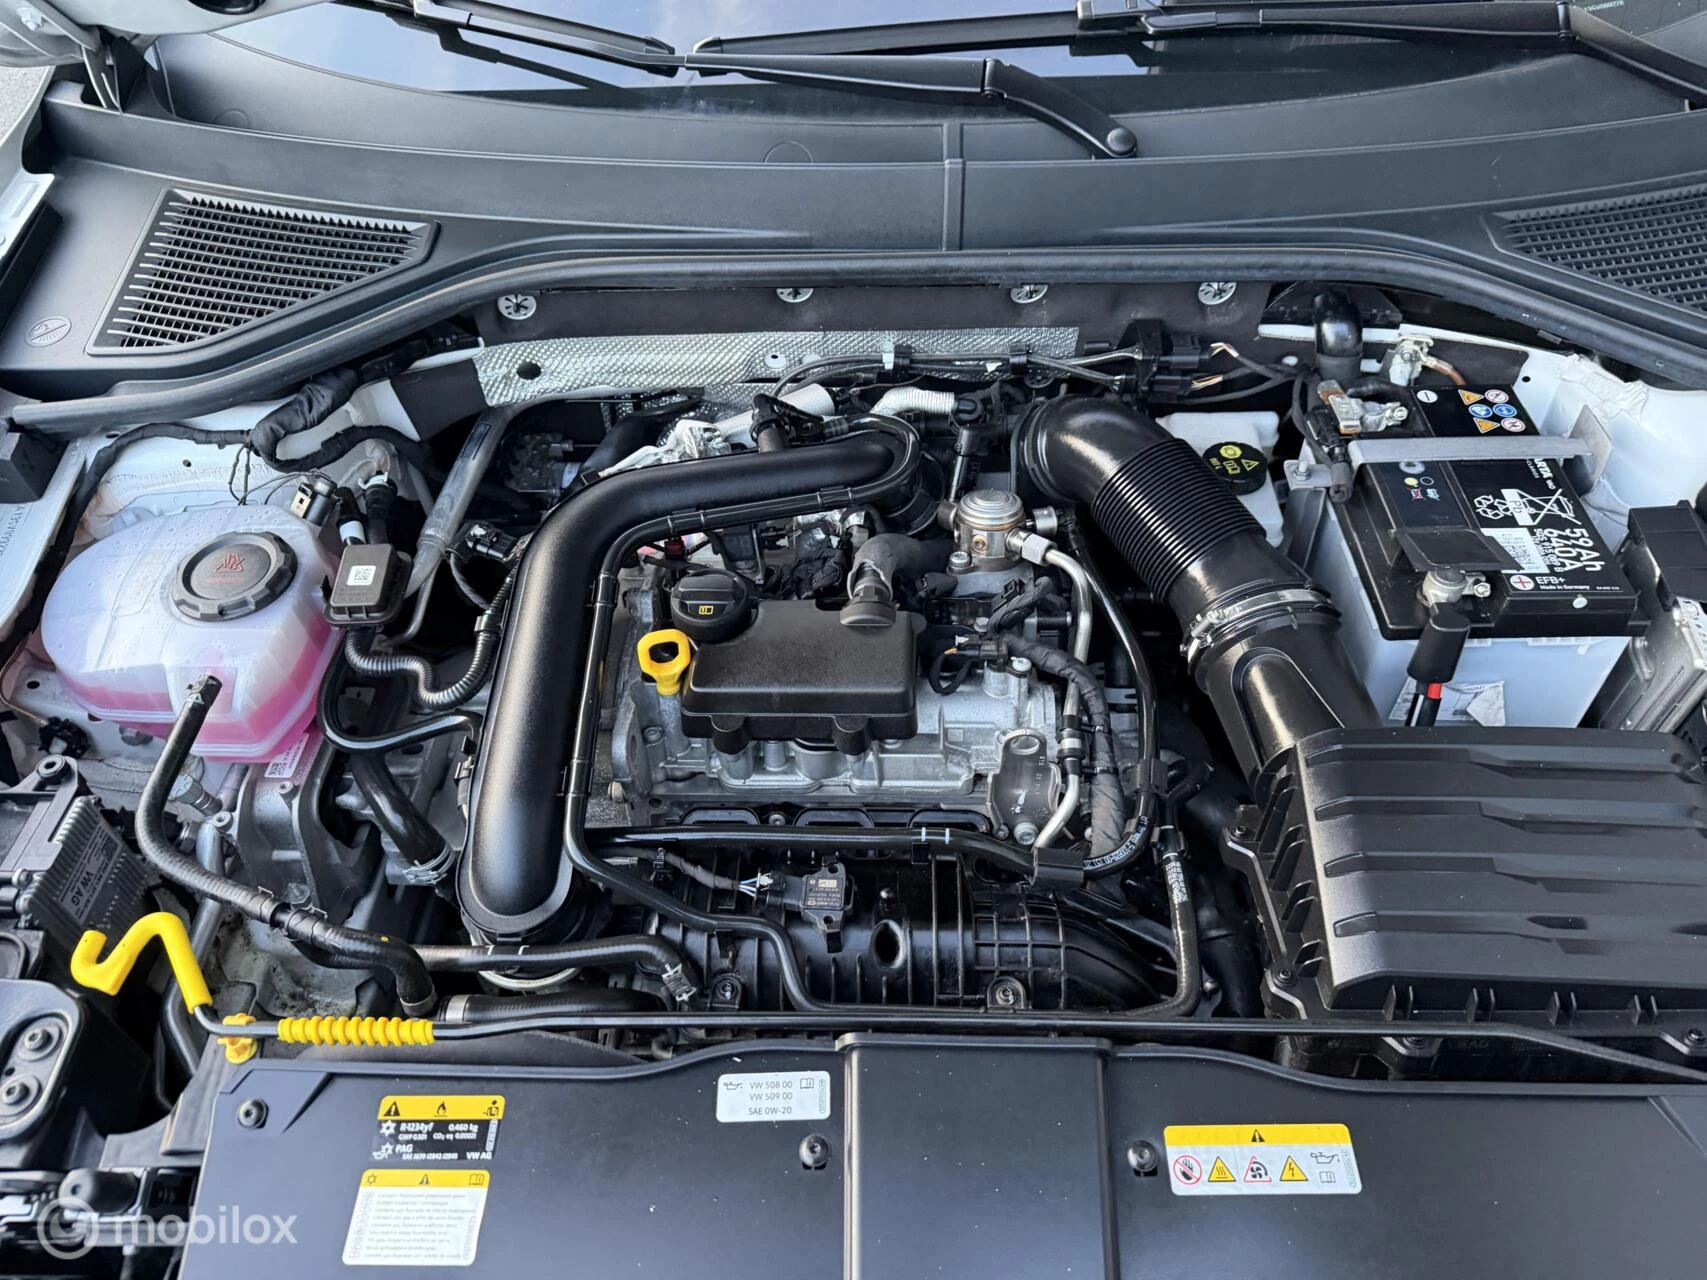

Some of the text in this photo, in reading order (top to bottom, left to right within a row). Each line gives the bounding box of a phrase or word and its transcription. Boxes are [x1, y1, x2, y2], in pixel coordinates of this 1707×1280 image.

[1544, 528, 1584, 572] 640A
[1565, 528, 1606, 572] 59Ah
[1535, 576, 1566, 584] EFB+
[71, 887, 85, 907] AG
[749, 1080, 793, 1090] VW 508 00
[749, 1093, 763, 1101] VW
[782, 1092, 793, 1100] 00
[748, 1106, 792, 1115] SAE 0W-20
[469, 1123, 479, 1133] kg
[395, 1144, 414, 1153] PAG
[466, 1152, 480, 1160] VW
[480, 1152, 493, 1160] AG
